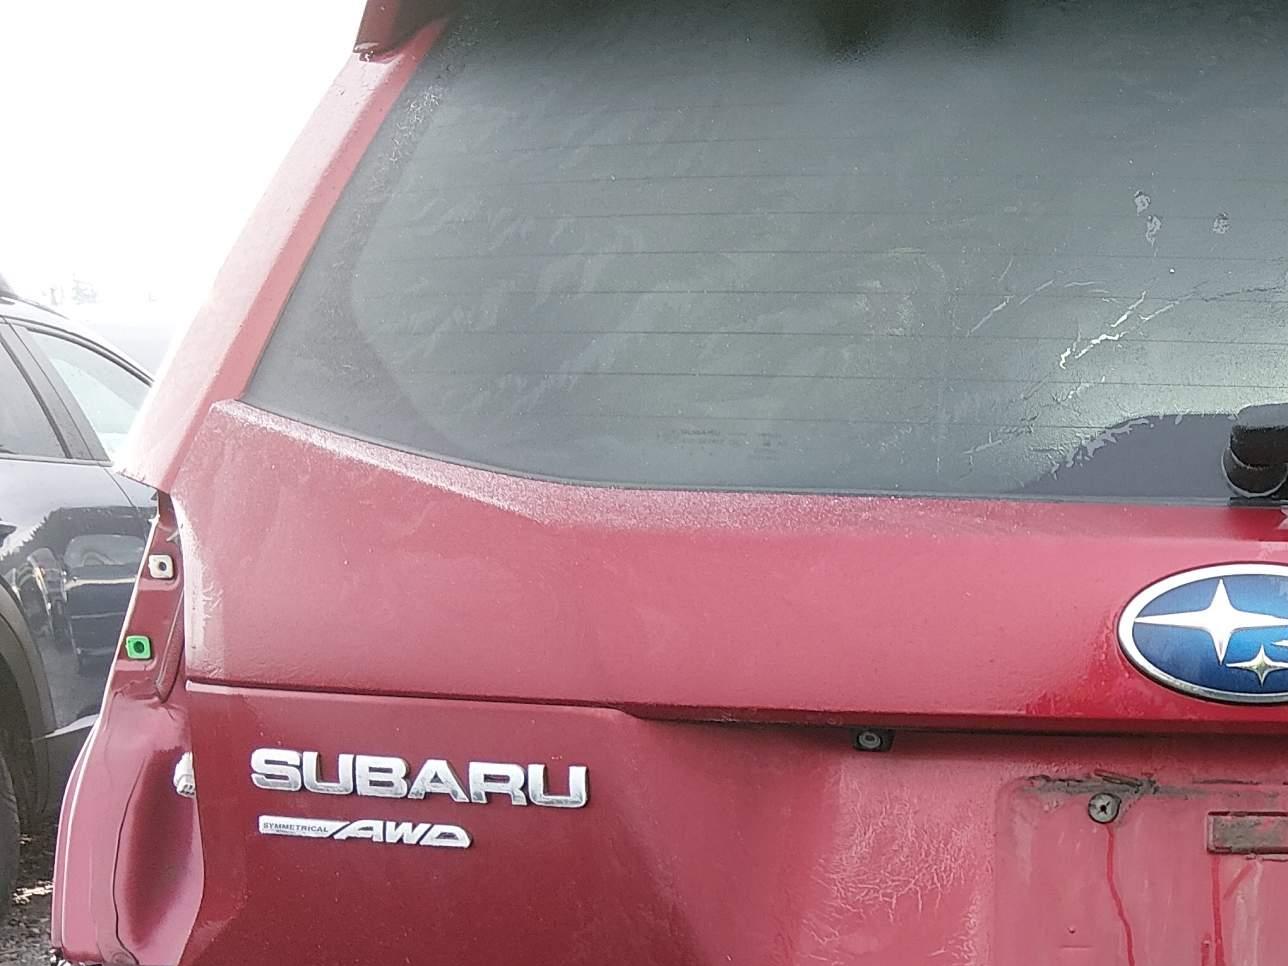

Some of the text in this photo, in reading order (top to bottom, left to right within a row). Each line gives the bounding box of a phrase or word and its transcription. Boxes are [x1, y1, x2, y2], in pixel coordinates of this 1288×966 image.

[250, 747, 589, 809] SUBARU
[262, 819, 473, 849] SYMMETRICAL AWD
